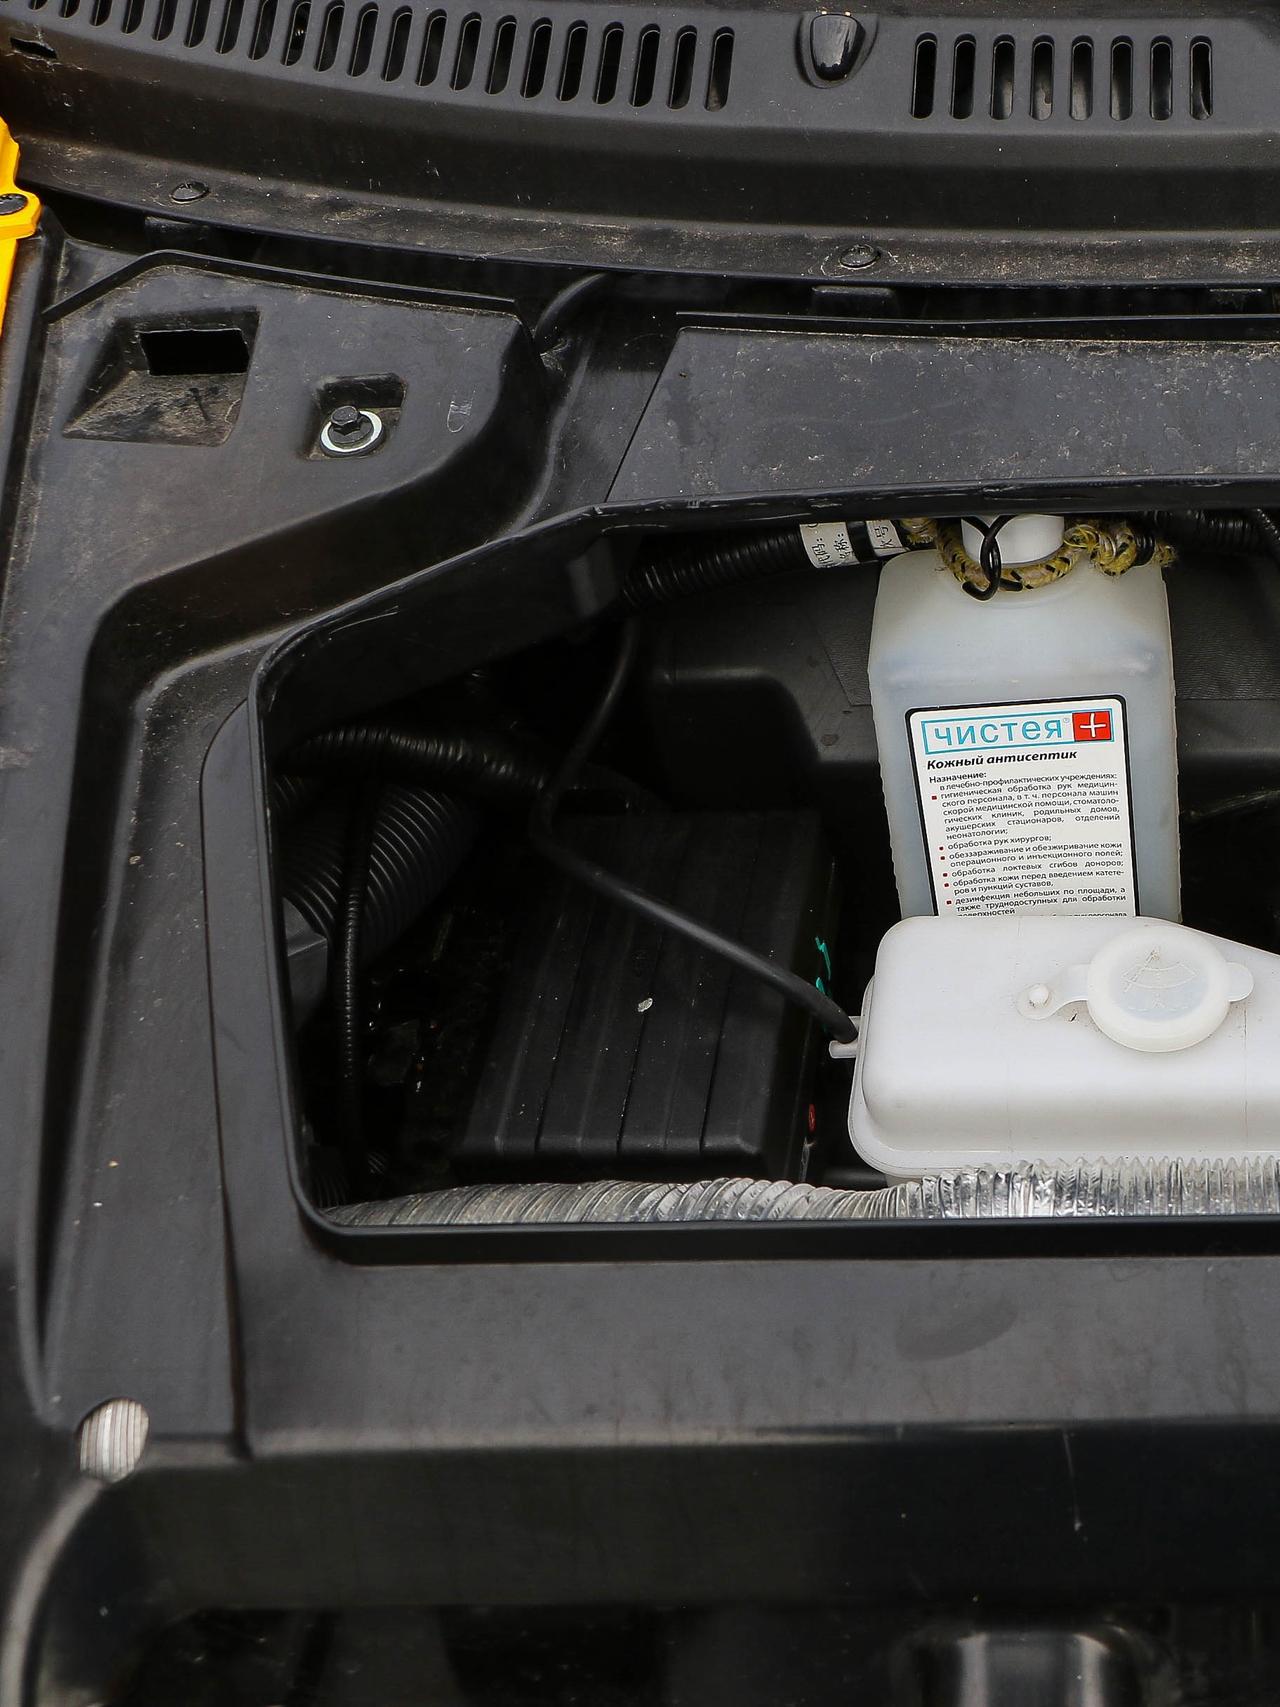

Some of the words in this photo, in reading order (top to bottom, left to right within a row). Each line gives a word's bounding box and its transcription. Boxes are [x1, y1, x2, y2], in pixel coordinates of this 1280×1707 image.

[927, 755, 984, 770] Кожный
[986, 751, 1078, 764] антисептик
[929, 772, 987, 784] Назначение:
[946, 775, 1059, 790] лечебно-профилактических
[1060, 773, 1118, 782] учреждениях:
[941, 787, 1002, 799] гигиеническая
[1007, 783, 1052, 793] обработка
[1057, 783, 1073, 791] рук
[1077, 781, 1118, 789] медицин-
[942, 799, 966, 808] ского
[967, 794, 1015, 805] персонала,
[1041, 790, 1087, 799] персонала
[943, 806, 975, 816] скорой
[975, 801, 1033, 812] медицинской
[1034, 800, 1072, 808] помощи,
[1073, 798, 1119, 806] стоматоло-
[944, 815, 983, 824] гических
[991, 811, 1025, 819] клиник,
[1033, 808, 1082, 817] родильных
[945, 821, 996, 833] акушерских
[1007, 816, 1065, 826] стационаров,
[1074, 814, 1121, 822] отделений
[946, 829, 1008, 841] неонатологии;
[947, 841, 992, 850] обработка
[1010, 835, 1052, 843] хирургов;
[949, 848, 1024, 860] обеззараживание
[1032, 843, 1099, 852] обезжиривание
[950, 855, 1016, 868] операционного
[1026, 851, 1093, 861] инъекционного
[1095, 849, 1123, 857] полей;
[952, 867, 996, 877] обработка
[1003, 864, 1042, 872] локтевых
[1049, 861, 1078, 869] сгибов
[1084, 860, 1124, 868] доноров;
[953, 877, 996, 887] обработка
[1021, 873, 1047, 881] перед
[1049, 871, 1094, 879] введением
[954, 887, 970, 896] ров
[978, 883, 1014, 893] пункций
[955, 894, 1011, 905] дезинфекция
[1013, 890, 1061, 898] небольших
[1077, 887, 1118, 895] площади,
[957, 904, 981, 912] также
[985, 897, 1058, 910] труднодоступных
[1062, 896, 1078, 904] для
[1081, 894, 1126, 903] обработки
